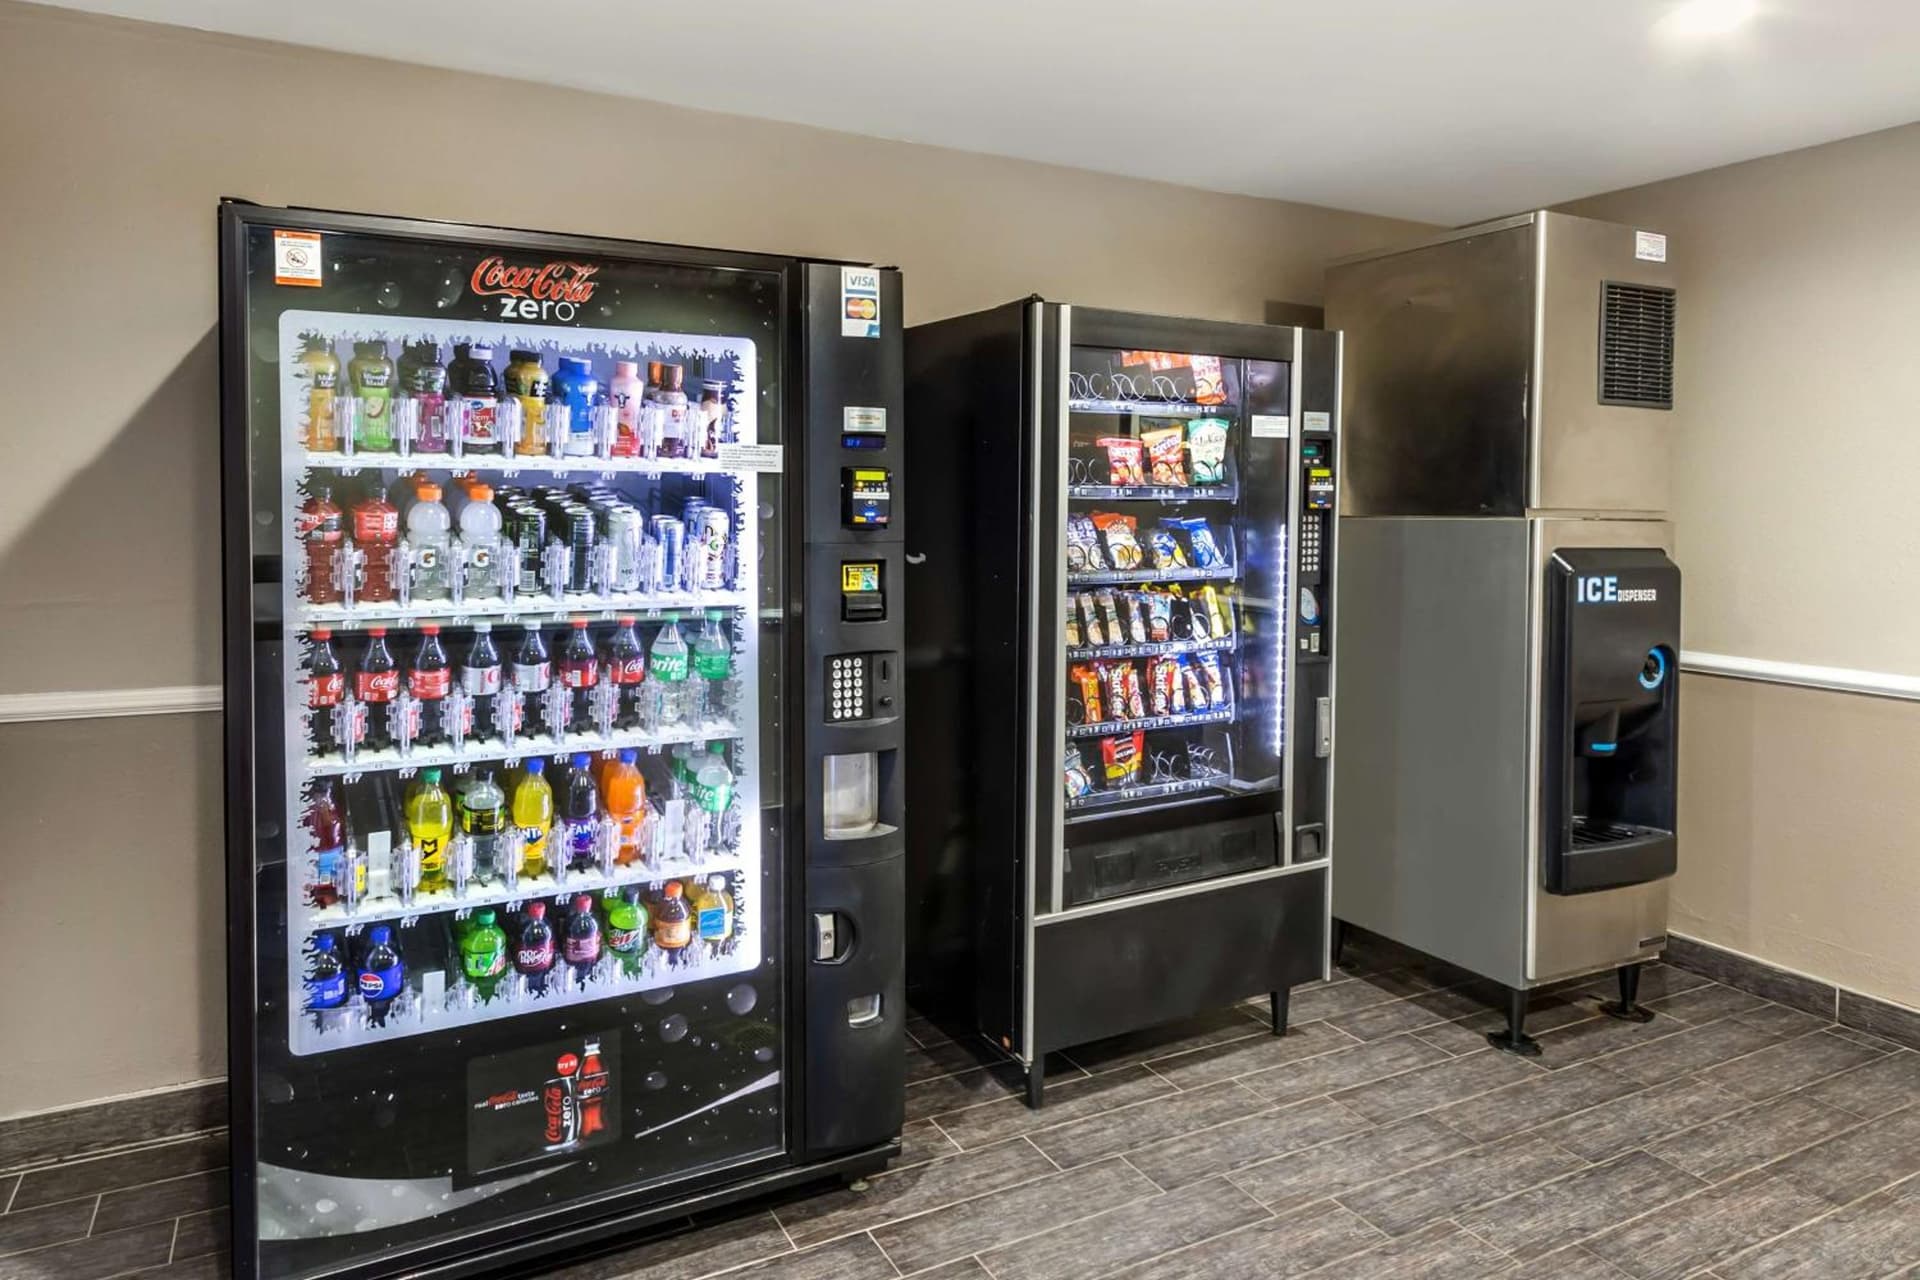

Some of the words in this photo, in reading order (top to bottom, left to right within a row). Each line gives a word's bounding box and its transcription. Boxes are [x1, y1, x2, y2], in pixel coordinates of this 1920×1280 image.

[471, 256, 599, 303] Coca-Cola
[850, 275, 876, 287] VISA
[500, 298, 575, 321] zero
[1577, 576, 1618, 602] ICE
[1618, 589, 1657, 602] DISPENSER
[544, 1087, 562, 1142] Coca-Cola
[562, 1096, 572, 1128] zero
